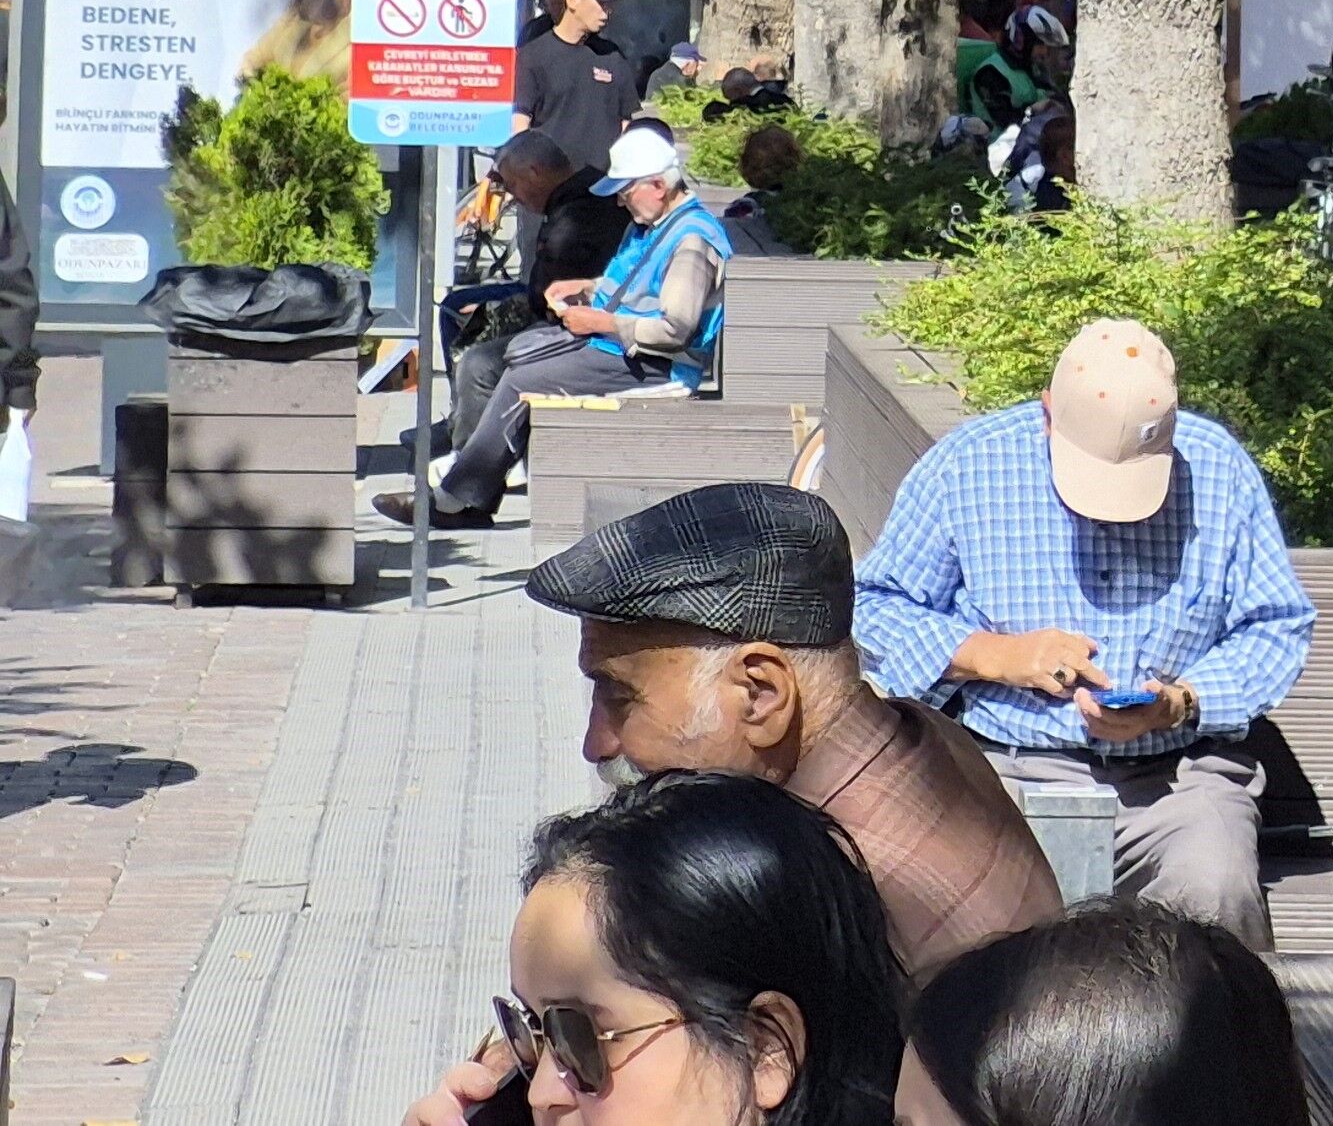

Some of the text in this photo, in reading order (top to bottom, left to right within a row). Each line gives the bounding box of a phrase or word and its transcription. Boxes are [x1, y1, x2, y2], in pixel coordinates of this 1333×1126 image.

[81, 6, 177, 28] BEDENE,
[80, 34, 197, 54] STRESTEN
[80, 61, 194, 83] DENGEYE.
[409, 111, 482, 122] ODUNPAZARI
